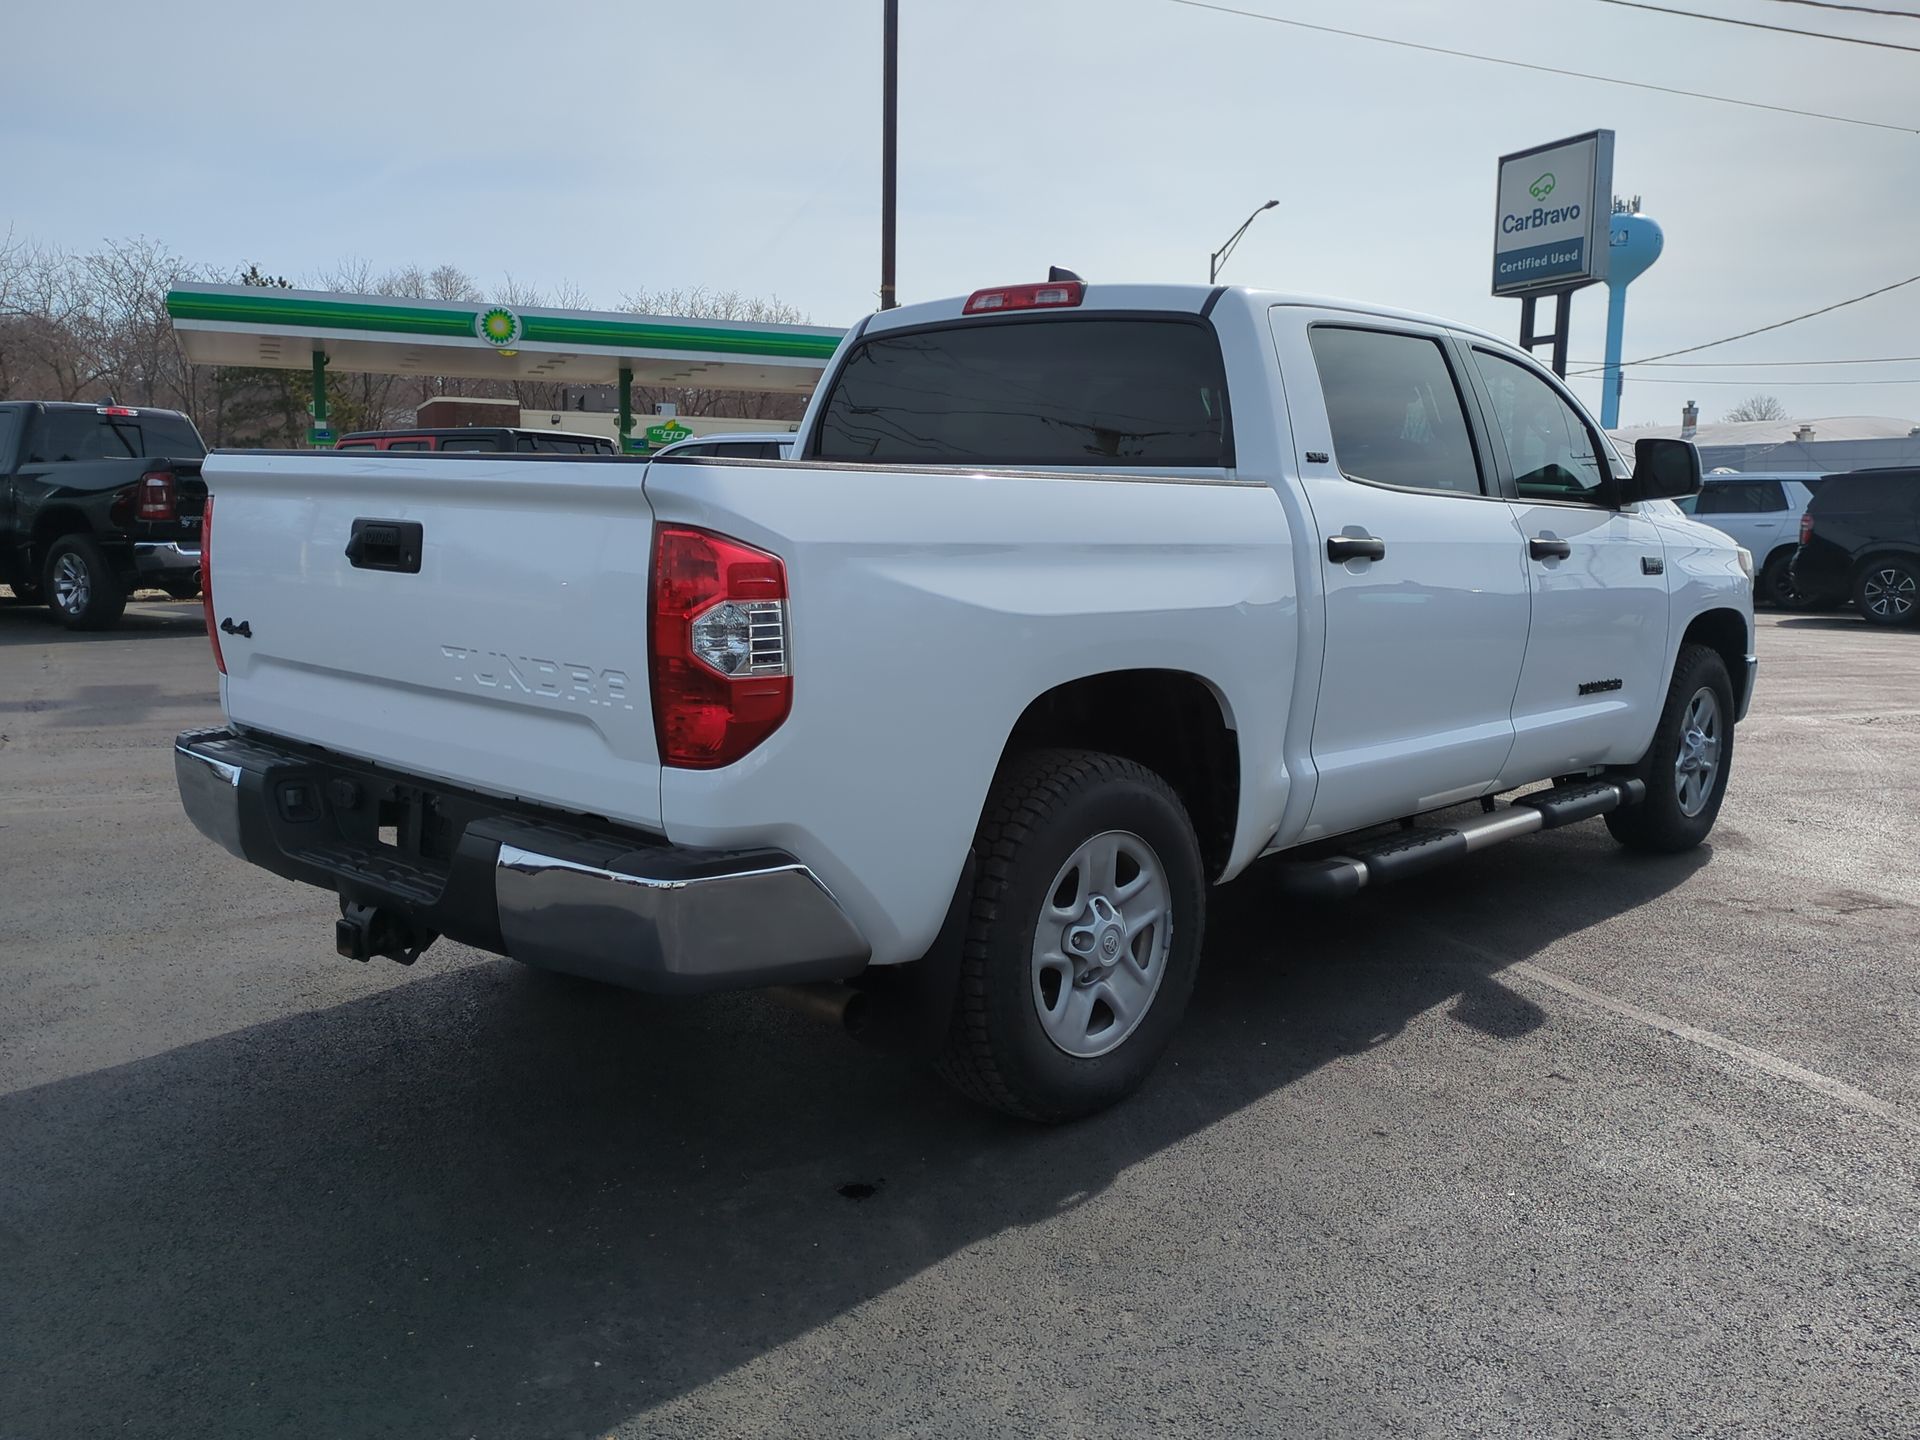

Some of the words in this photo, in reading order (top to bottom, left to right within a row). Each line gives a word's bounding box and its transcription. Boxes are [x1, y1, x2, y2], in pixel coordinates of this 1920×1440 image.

[1502, 204, 1580, 233] CarBravo
[1500, 255, 1548, 273] Certified
[1551, 249, 1578, 265] Used
[661, 430, 686, 442] go
[440, 644, 634, 710] TUNDRA
